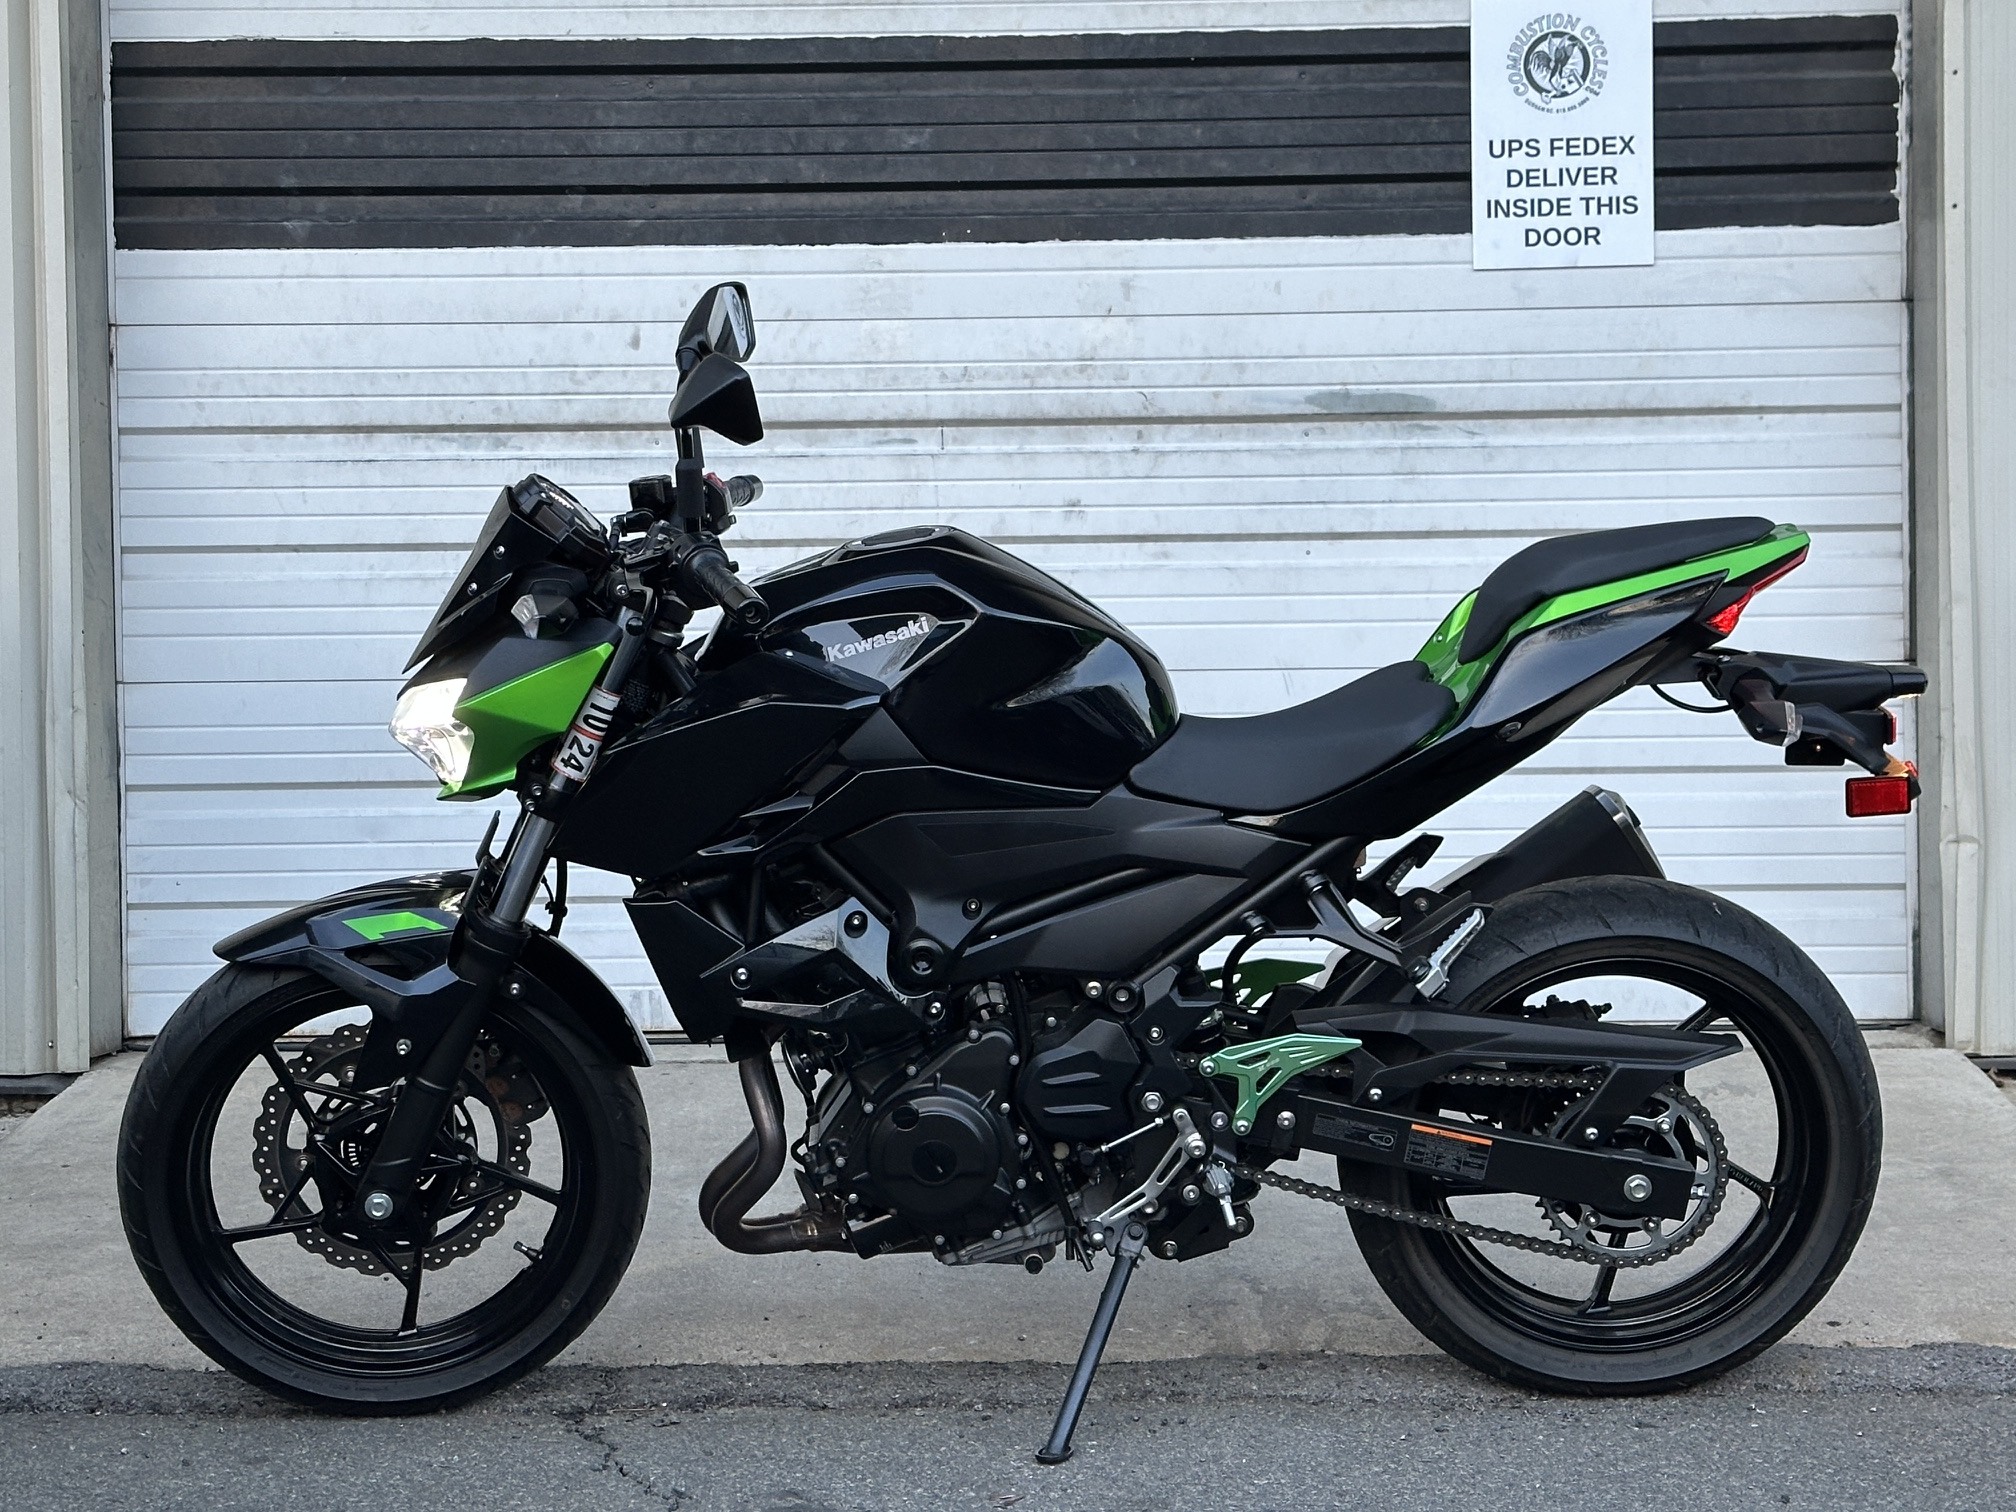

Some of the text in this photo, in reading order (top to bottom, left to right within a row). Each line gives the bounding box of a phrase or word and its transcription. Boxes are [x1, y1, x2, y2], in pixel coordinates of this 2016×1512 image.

[1506, 13, 1609, 97] COMBUSTION CYCLES
[1488, 135, 1636, 159] UPS FEDEX
[1506, 166, 1618, 188] DELIVER
[1486, 195, 1639, 219] INSIDE THIS
[1524, 226, 1602, 248] DOOR
[827, 616, 930, 662] Kawasaki
[560, 735, 595, 773] 24
